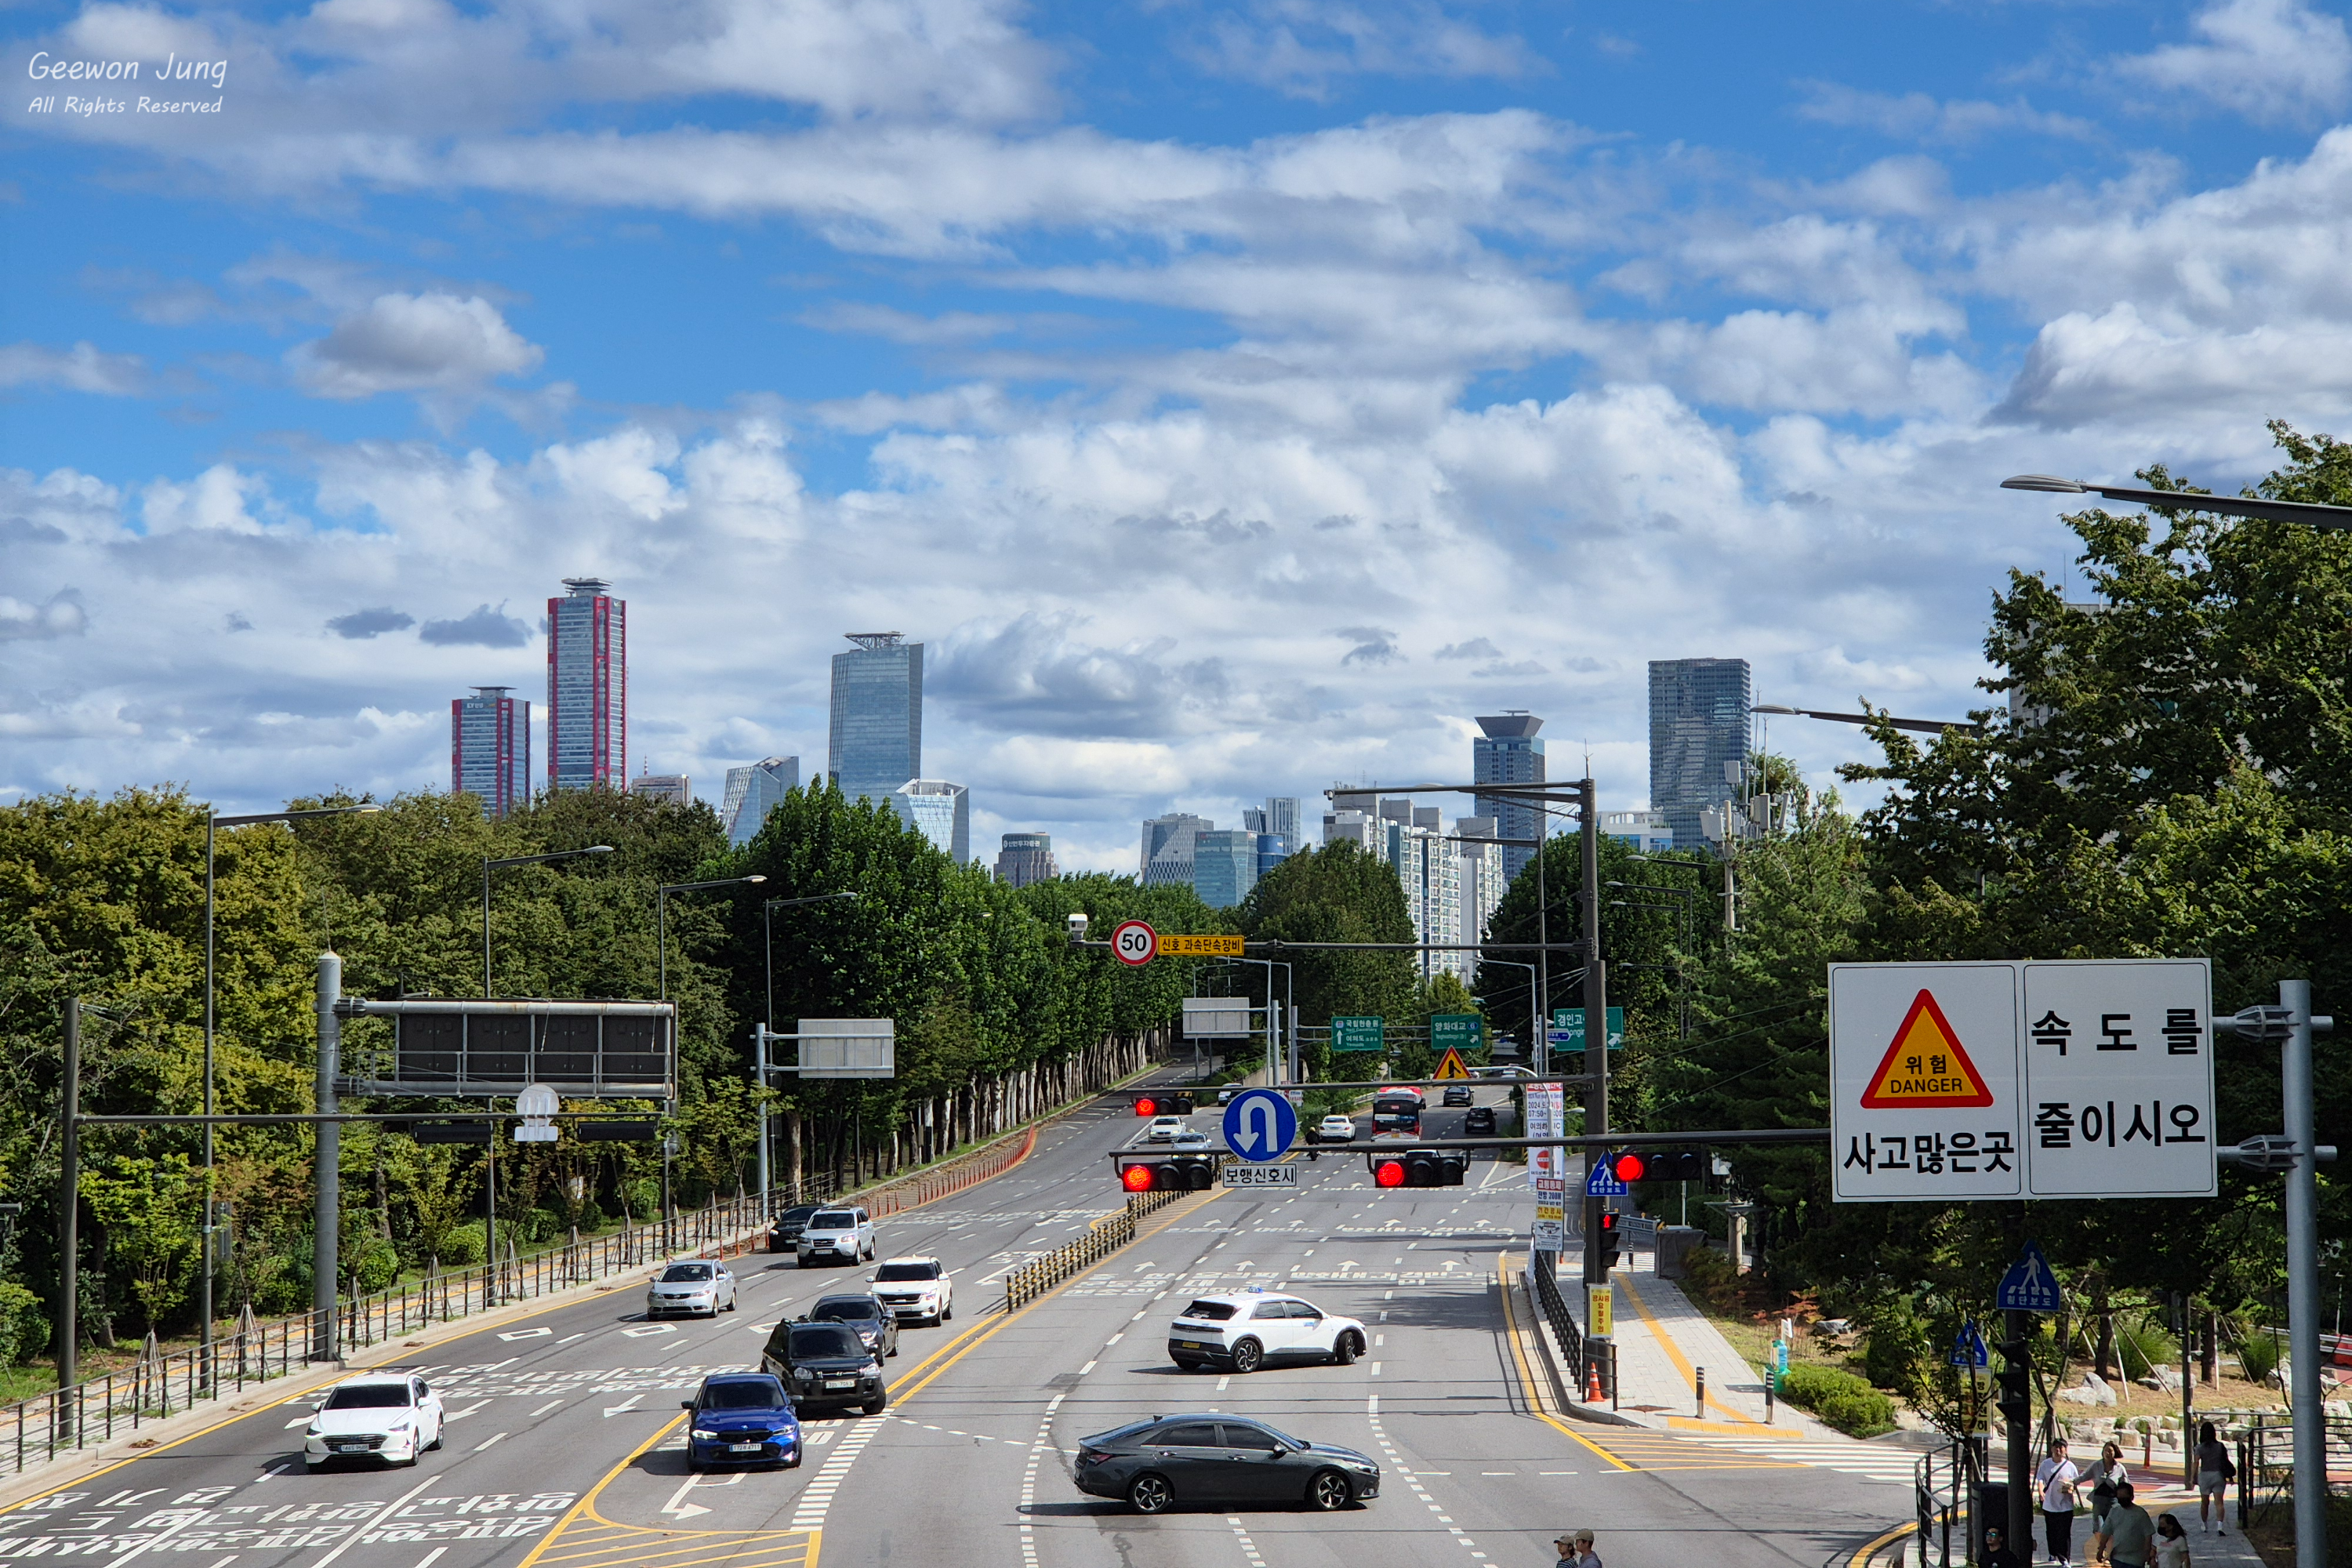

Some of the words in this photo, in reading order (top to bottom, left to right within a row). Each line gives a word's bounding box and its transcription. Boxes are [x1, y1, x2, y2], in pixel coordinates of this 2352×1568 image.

[1121, 933, 1147, 952] 50
[1162, 938, 1180, 952] 신호
[1184, 938, 1240, 953] 과속단속장비
[1434, 1022, 1467, 1032] 양화대교
[1557, 1013, 1584, 1027] 경인고
[1905, 1054, 1947, 1075] 위험
[1890, 1078, 1963, 1094] DANGER
[2034, 1100, 2205, 1149] 줄이시오
[1844, 1132, 2014, 1174] 사고많은곳
[1226, 1167, 1294, 1184] 보행신호시
[2007, 1295, 2052, 1306] 횡단보도
[194, 1501, 387, 1526] 양화교
[393, 1491, 578, 1518] 양화교
[151, 1523, 355, 1552] 김포공항
[362, 1515, 557, 1544] 김포공항
